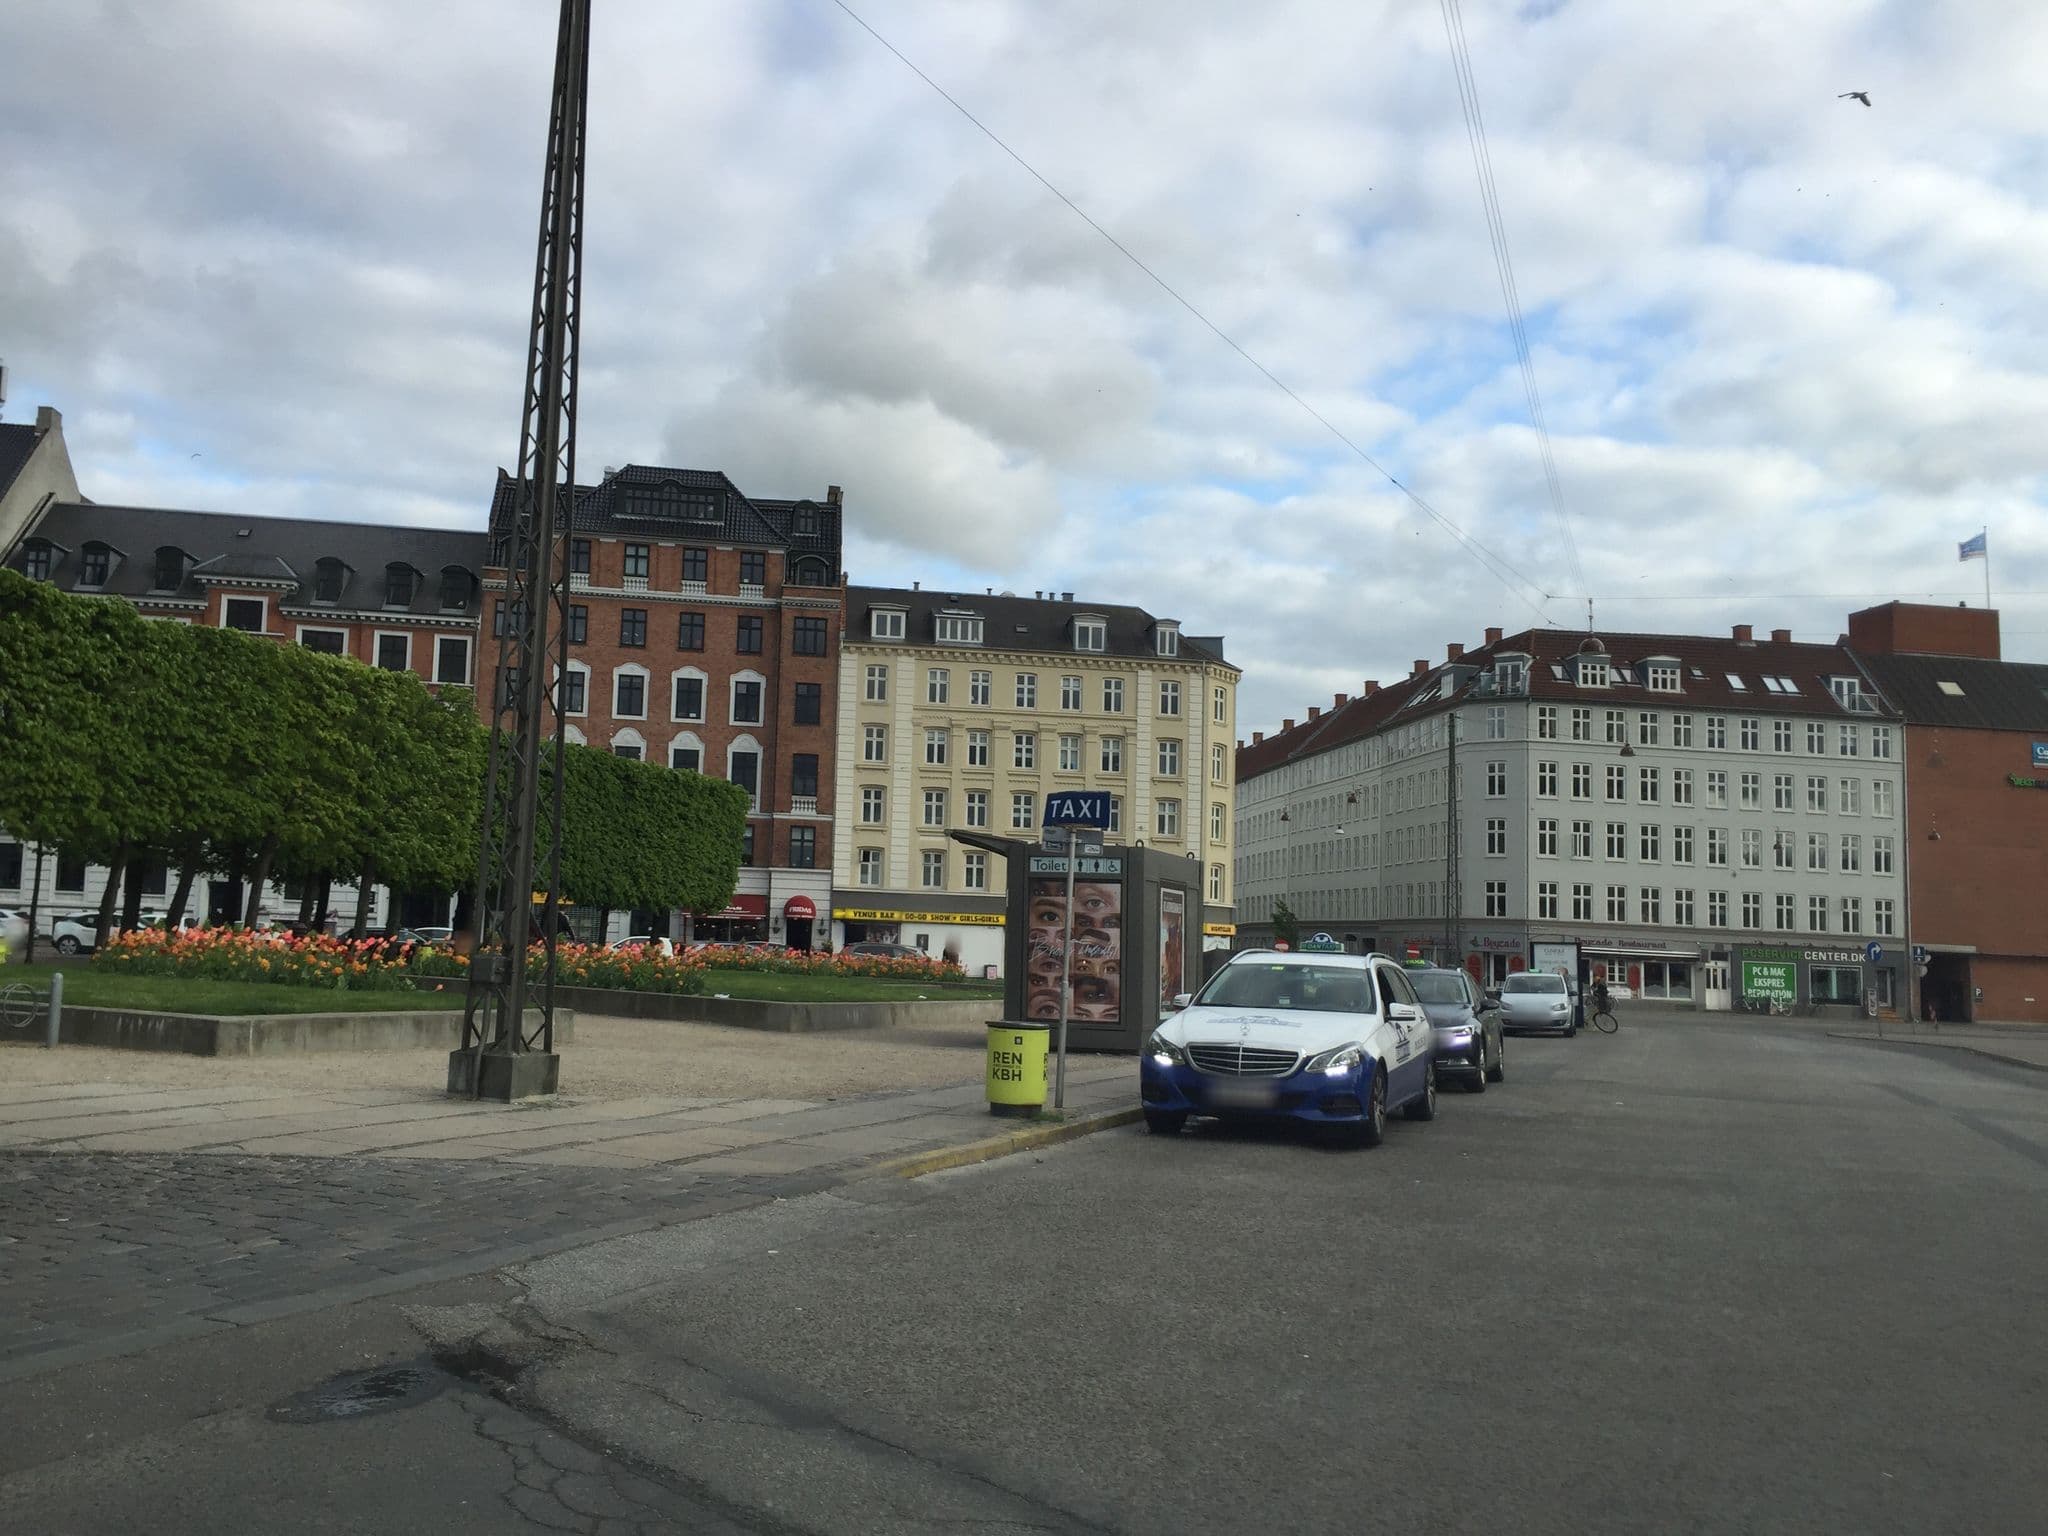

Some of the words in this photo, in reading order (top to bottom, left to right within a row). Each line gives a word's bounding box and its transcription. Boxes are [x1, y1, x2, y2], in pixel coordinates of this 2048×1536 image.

[1051, 798, 1100, 818] TAXI
[1033, 858, 1067, 871] Toilet
[853, 911, 877, 919] VENUS
[1752, 967, 1762, 976] PC
[1769, 967, 1786, 977] MAC
[1753, 977, 1785, 988] EKSPRES
[993, 1051, 1023, 1065] REN
[992, 1068, 1023, 1082] KBH
